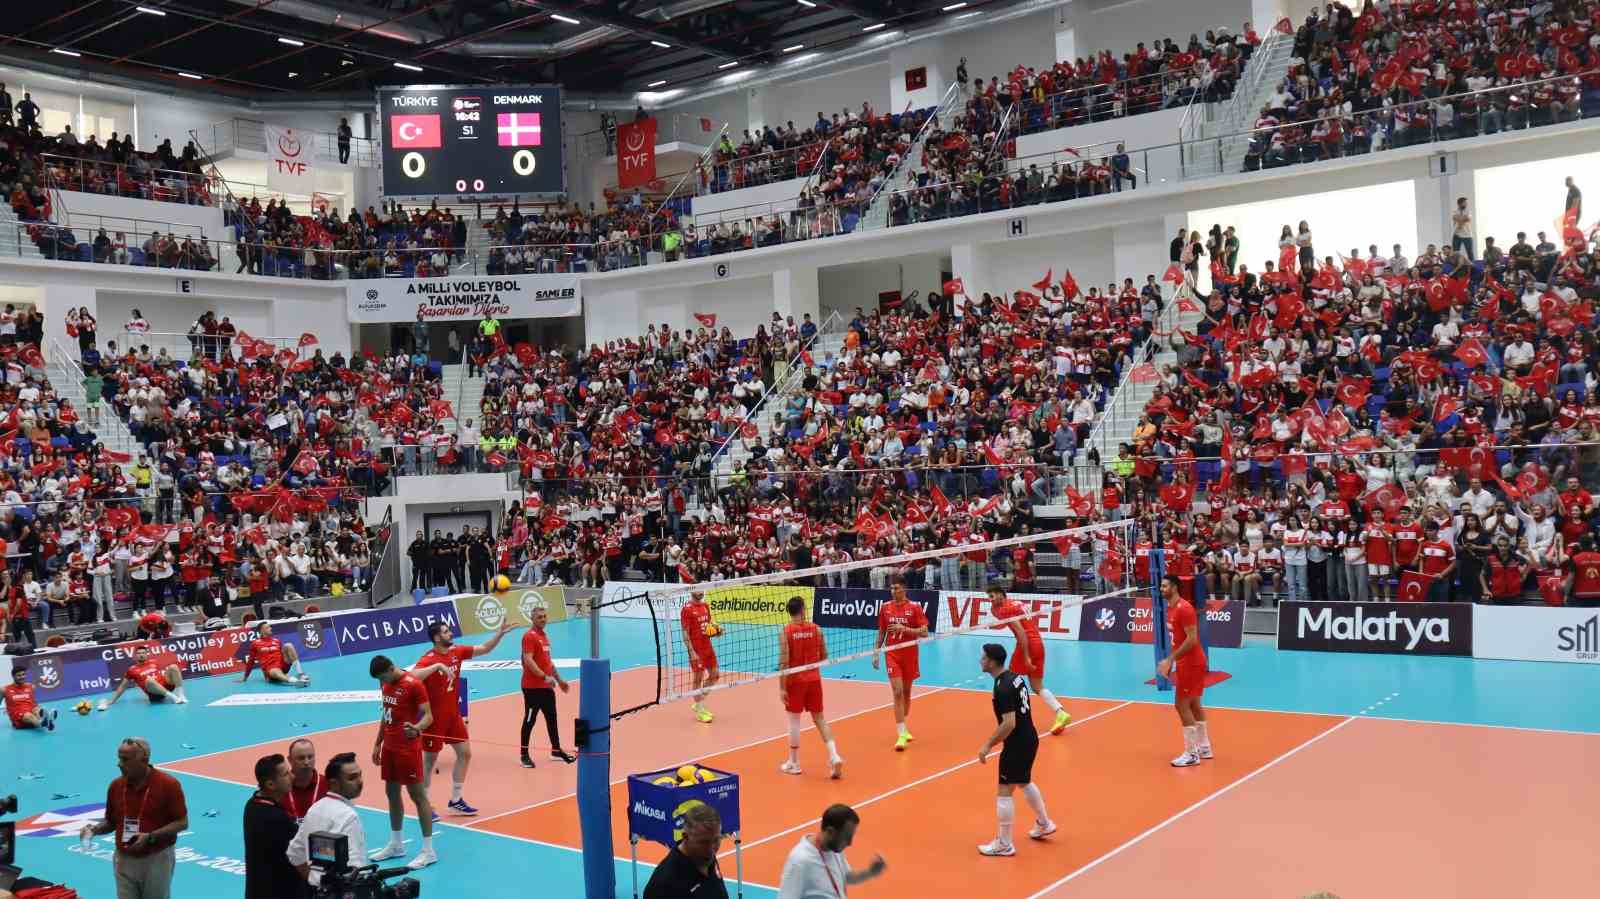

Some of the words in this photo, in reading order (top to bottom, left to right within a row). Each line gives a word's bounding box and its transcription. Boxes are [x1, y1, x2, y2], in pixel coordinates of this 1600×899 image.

[392, 95, 439, 107] TÜRKİYE
[494, 94, 542, 105] DENMARK
[275, 159, 306, 176] TVF
[402, 151, 426, 179] 0
[512, 149, 536, 176] 0
[623, 152, 649, 171] TVF
[456, 179, 467, 192] 0
[473, 178, 485, 192] 0
[1012, 219, 1022, 234] H
[717, 264, 726, 277] G
[182, 280, 190, 293] E
[407, 283, 416, 295] A
[453, 280, 520, 293] VOLEYBOL
[561, 288, 575, 297] ER
[428, 293, 500, 307] TAKIMIMIZA
[710, 595, 789, 612] sahibinden.c
[947, 596, 1070, 633] VEEL
[1128, 607, 1149, 618] CEV
[1206, 610, 1231, 621] 2026
[1298, 606, 1450, 650] Malatya
[102, 646, 136, 661] CEV
[145, 636, 225, 655] uroVolley
[177, 652, 203, 662] Men
[80, 676, 111, 690] Italy
[191, 658, 234, 673] Finland
